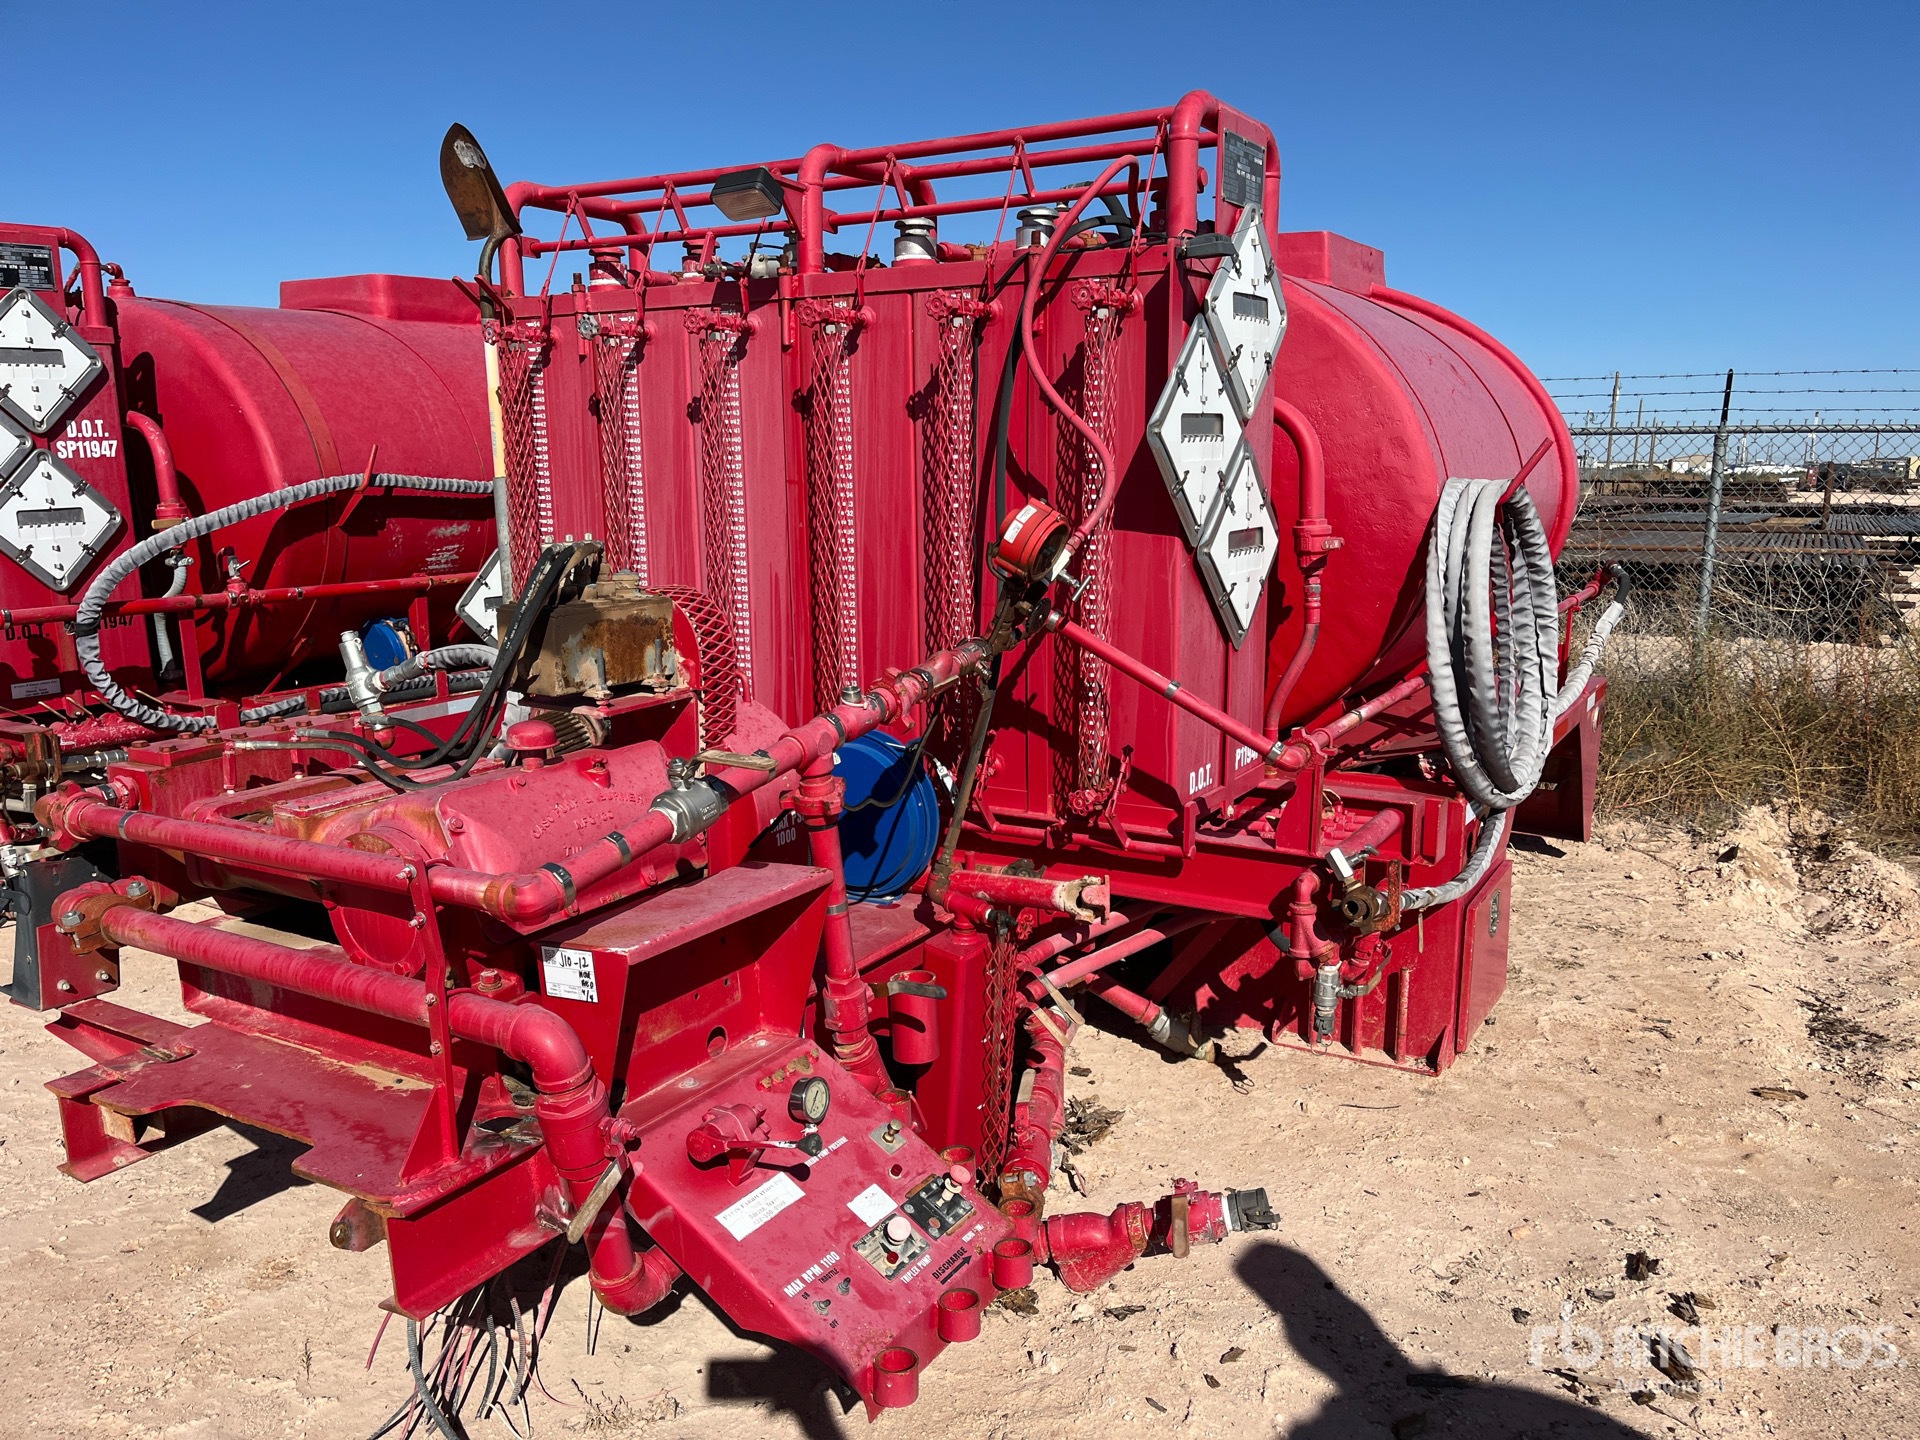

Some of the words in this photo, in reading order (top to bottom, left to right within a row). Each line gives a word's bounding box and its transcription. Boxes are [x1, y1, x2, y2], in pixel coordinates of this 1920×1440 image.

[66, 420, 109, 438] D.O.T.
[56, 440, 118, 458] SP11947
[1190, 763, 1212, 796] D.O.T.
[776, 828, 796, 846] 1000
[900, 1263, 920, 1284] TRIPLEX
[917, 1254, 932, 1270] PUMP
[932, 1246, 968, 1280] DISCHARGE
[783, 1278, 806, 1298] MAX
[801, 1264, 824, 1284] RPM
[820, 1251, 840, 1268] 1100
[818, 1268, 840, 1284] THROTTLE
[802, 1292, 810, 1300] ON
[829, 1318, 840, 1328] OFF
